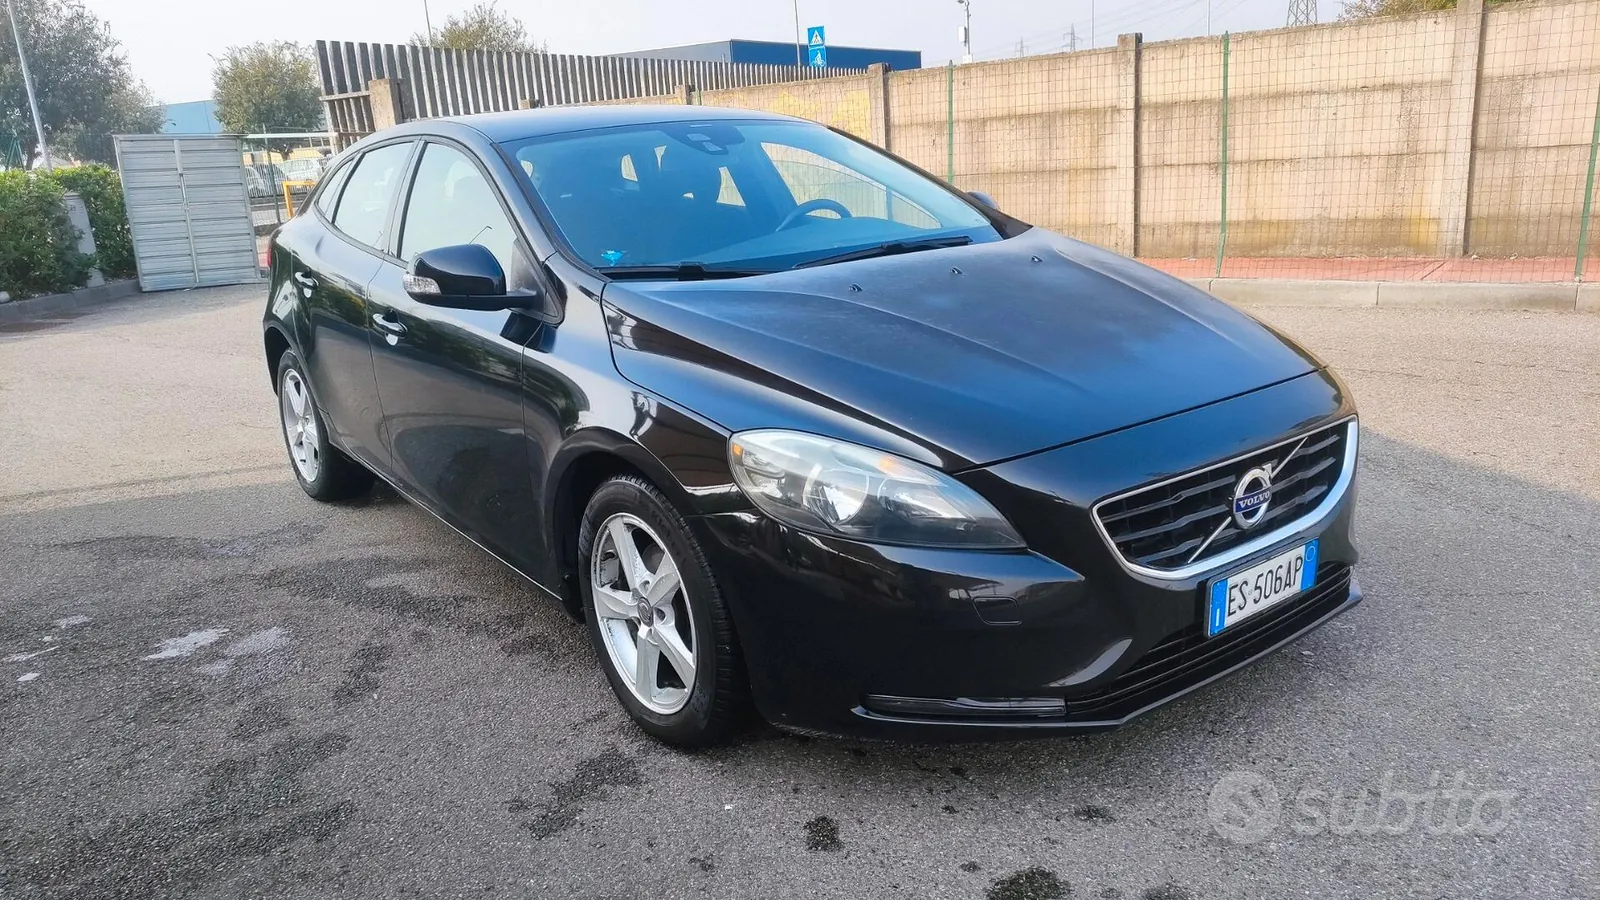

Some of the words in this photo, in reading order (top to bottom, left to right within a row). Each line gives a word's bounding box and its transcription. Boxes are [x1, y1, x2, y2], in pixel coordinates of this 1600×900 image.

[1238, 490, 1271, 508] VOLVO
[1227, 580, 1249, 617] ES
[1253, 554, 1304, 605] 506AP
